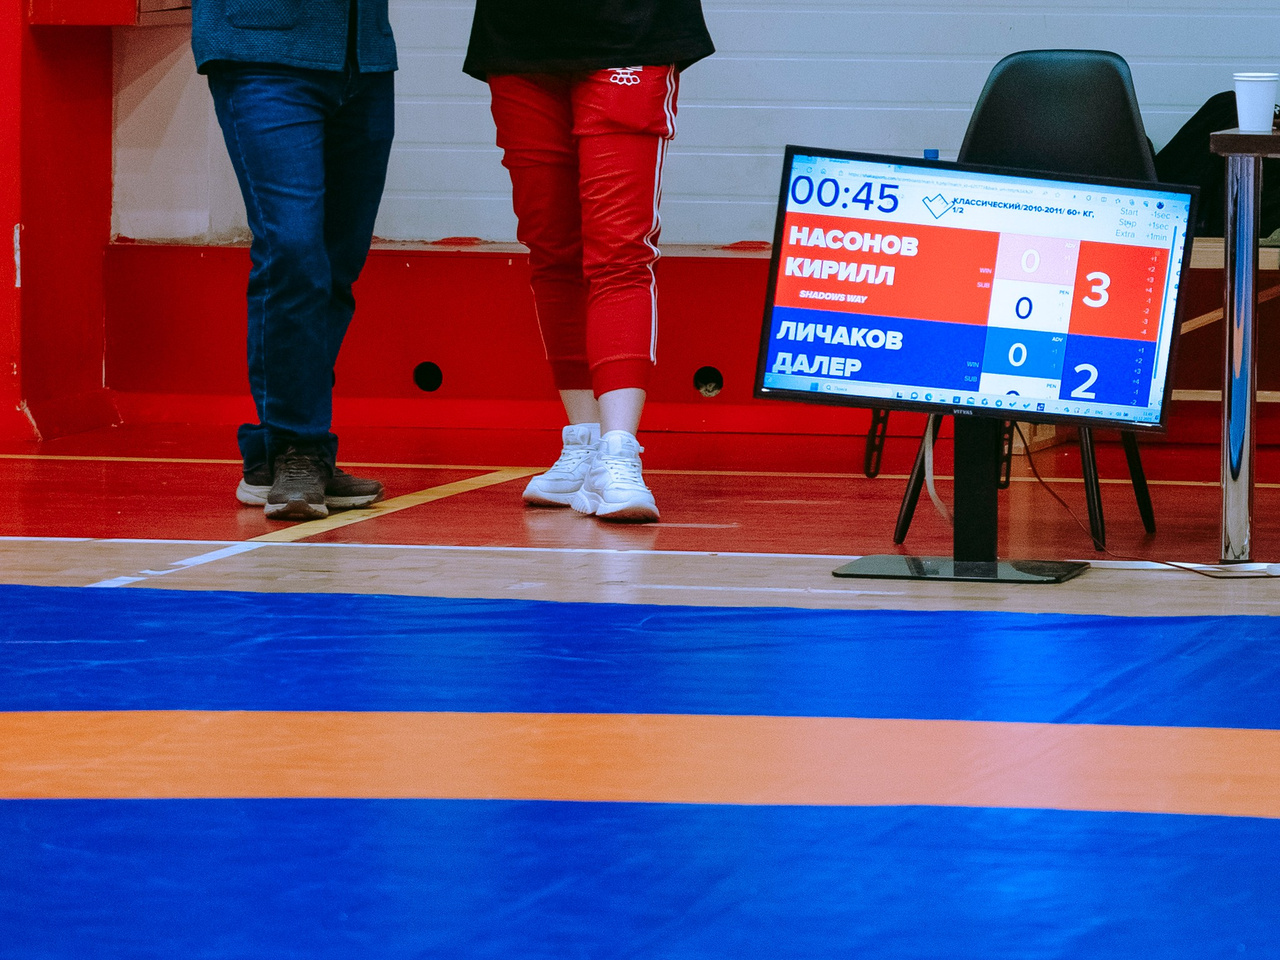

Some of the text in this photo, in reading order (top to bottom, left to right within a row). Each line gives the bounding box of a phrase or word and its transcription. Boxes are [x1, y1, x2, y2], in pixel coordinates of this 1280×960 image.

[791, 175, 900, 214] 00:45
[1120, 207, 1138, 216] Start
[1115, 229, 1135, 238] Extra
[1148, 221, 1169, 230] +1sec
[788, 225, 919, 257] НАСОНОВ
[785, 256, 896, 286] КИРИЛЛ
[1021, 248, 1041, 274] 0
[799, 290, 868, 304] SHADOWS WAY
[1082, 271, 1111, 308] 3
[1015, 296, 1033, 320] 0
[777, 321, 903, 350] ЛИЧАКОВ
[772, 351, 862, 377] ДАЛЕР
[966, 360, 979, 368] WIN
[1008, 342, 1028, 367] 0
[1070, 363, 1099, 400] 2
